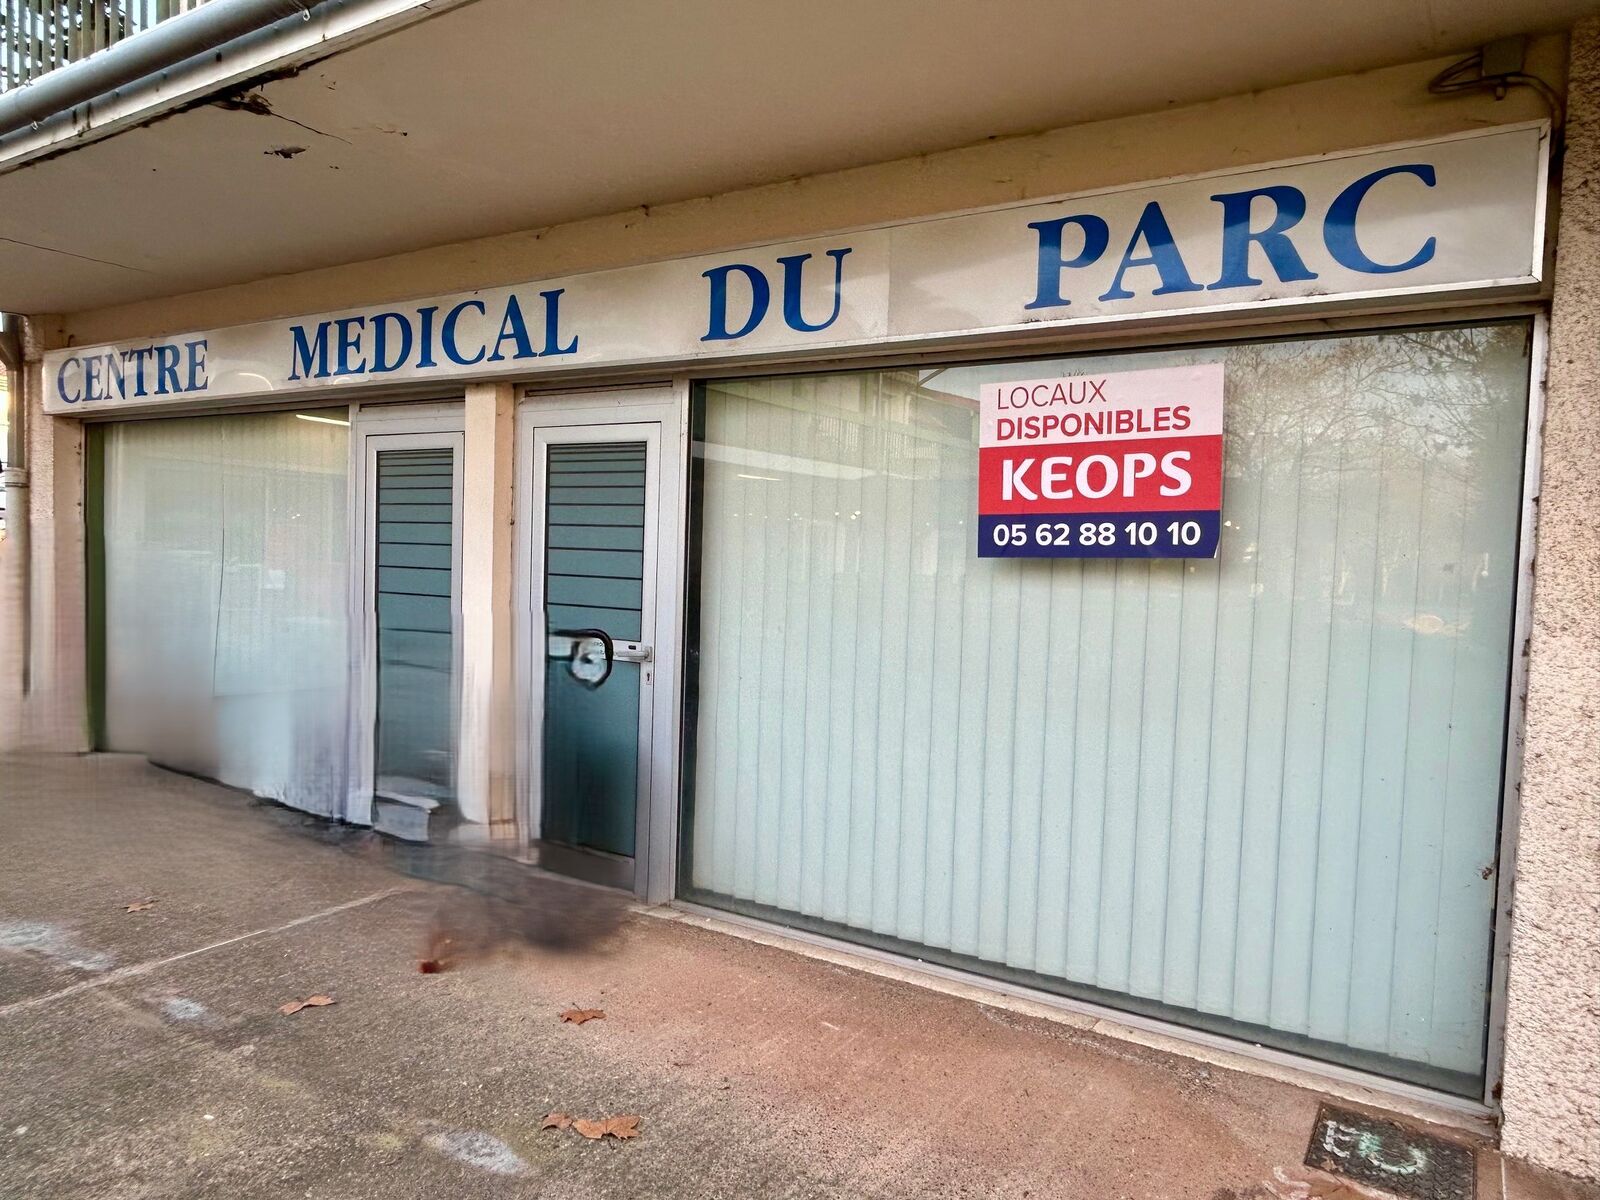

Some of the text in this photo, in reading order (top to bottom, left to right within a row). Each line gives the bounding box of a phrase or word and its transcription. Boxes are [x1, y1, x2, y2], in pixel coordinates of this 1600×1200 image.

[57, 164, 1437, 403] CENTRE MEDICAL DU PARC
[997, 379, 1107, 410] LOCAUX
[996, 405, 1191, 441] DISPONIBLES
[1002, 451, 1192, 501] KEOPS
[993, 521, 1201, 546] 05 62 88 10 10
